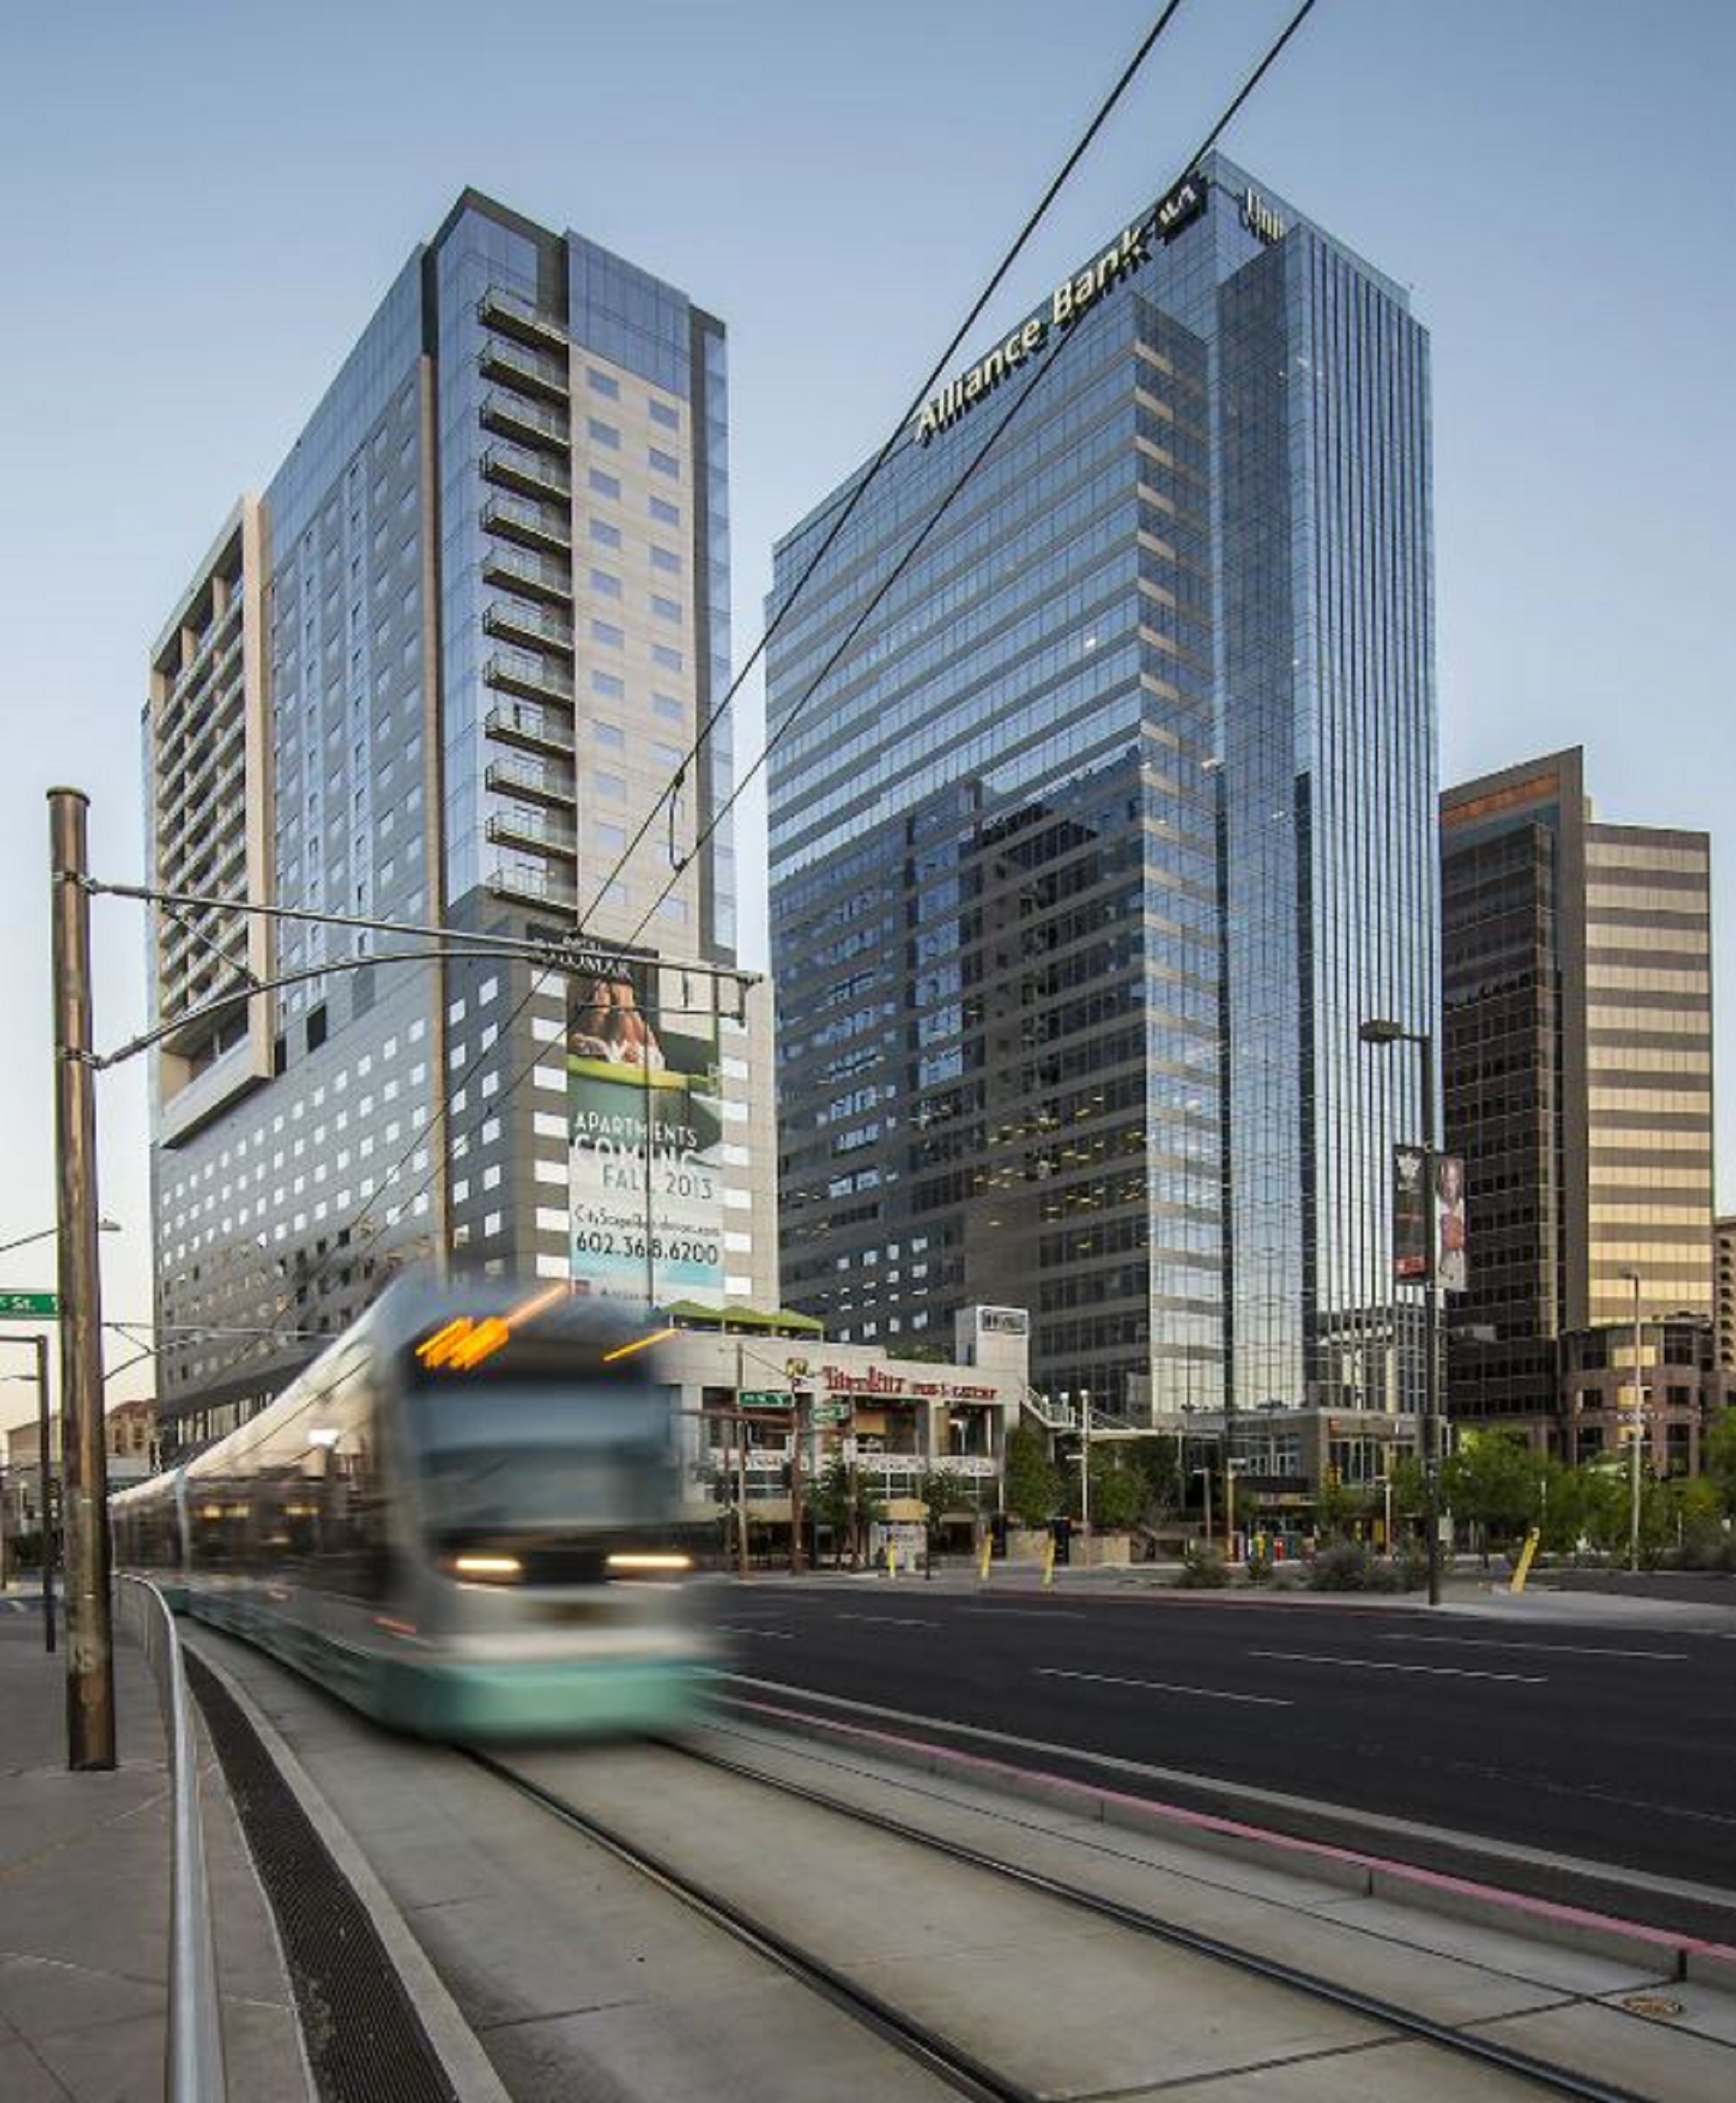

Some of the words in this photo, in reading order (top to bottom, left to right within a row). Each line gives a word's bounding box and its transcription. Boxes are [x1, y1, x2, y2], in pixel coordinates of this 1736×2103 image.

[915, 318, 1041, 444] Alliance
[1053, 226, 1142, 324] Bank
[603, 1164, 655, 1195] FAL
[666, 1170, 711, 1199] 2013
[576, 1230, 718, 1266] 602.368.6200
